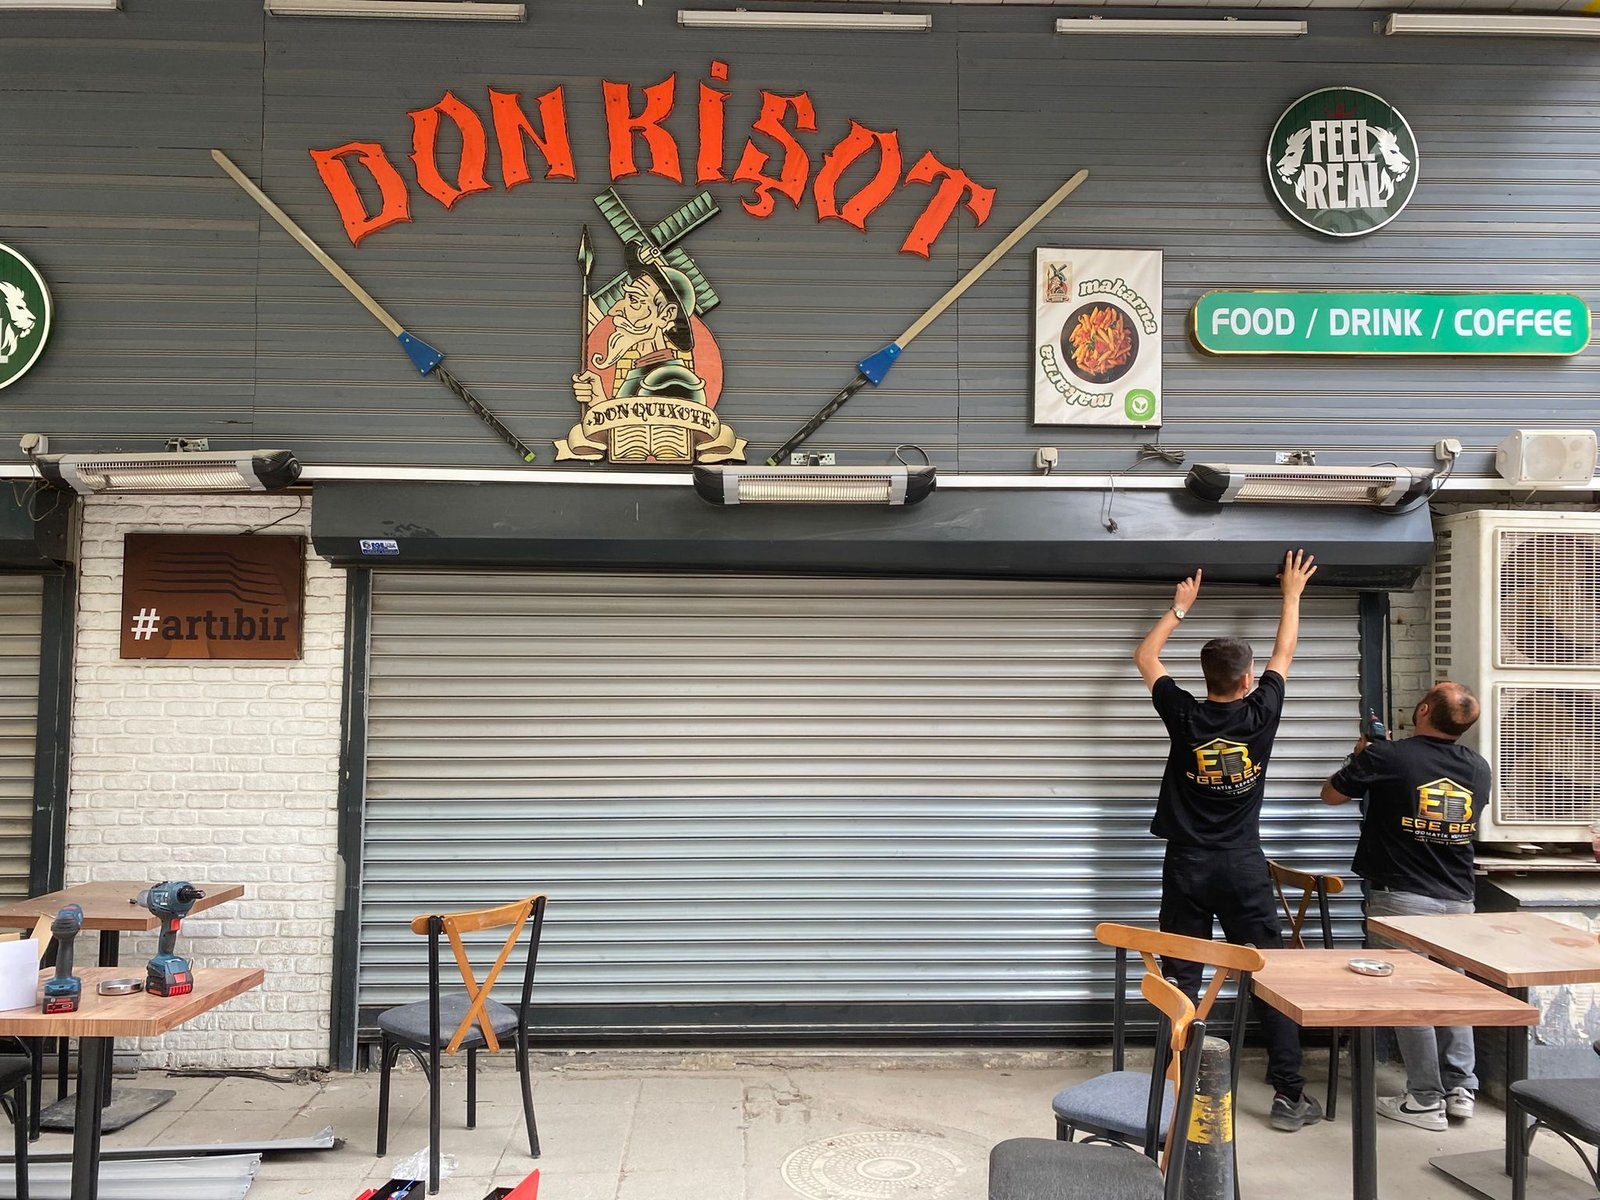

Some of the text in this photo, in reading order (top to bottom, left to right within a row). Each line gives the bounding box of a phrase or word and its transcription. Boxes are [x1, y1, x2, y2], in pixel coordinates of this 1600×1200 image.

[308, 60, 996, 259] DON KİŞOT
[1310, 119, 1376, 163] FEEL
[1304, 162, 1388, 210] REAL
[1078, 278, 1158, 335] makarna
[1211, 307, 1573, 340] FOOD / DRINK / COFFEE
[1040, 344, 1114, 408] makarna
[592, 402, 712, 429] DON QUIXOTE
[1230, 762, 1262, 783] BEK
[1401, 816, 1477, 833] EGE BEK
